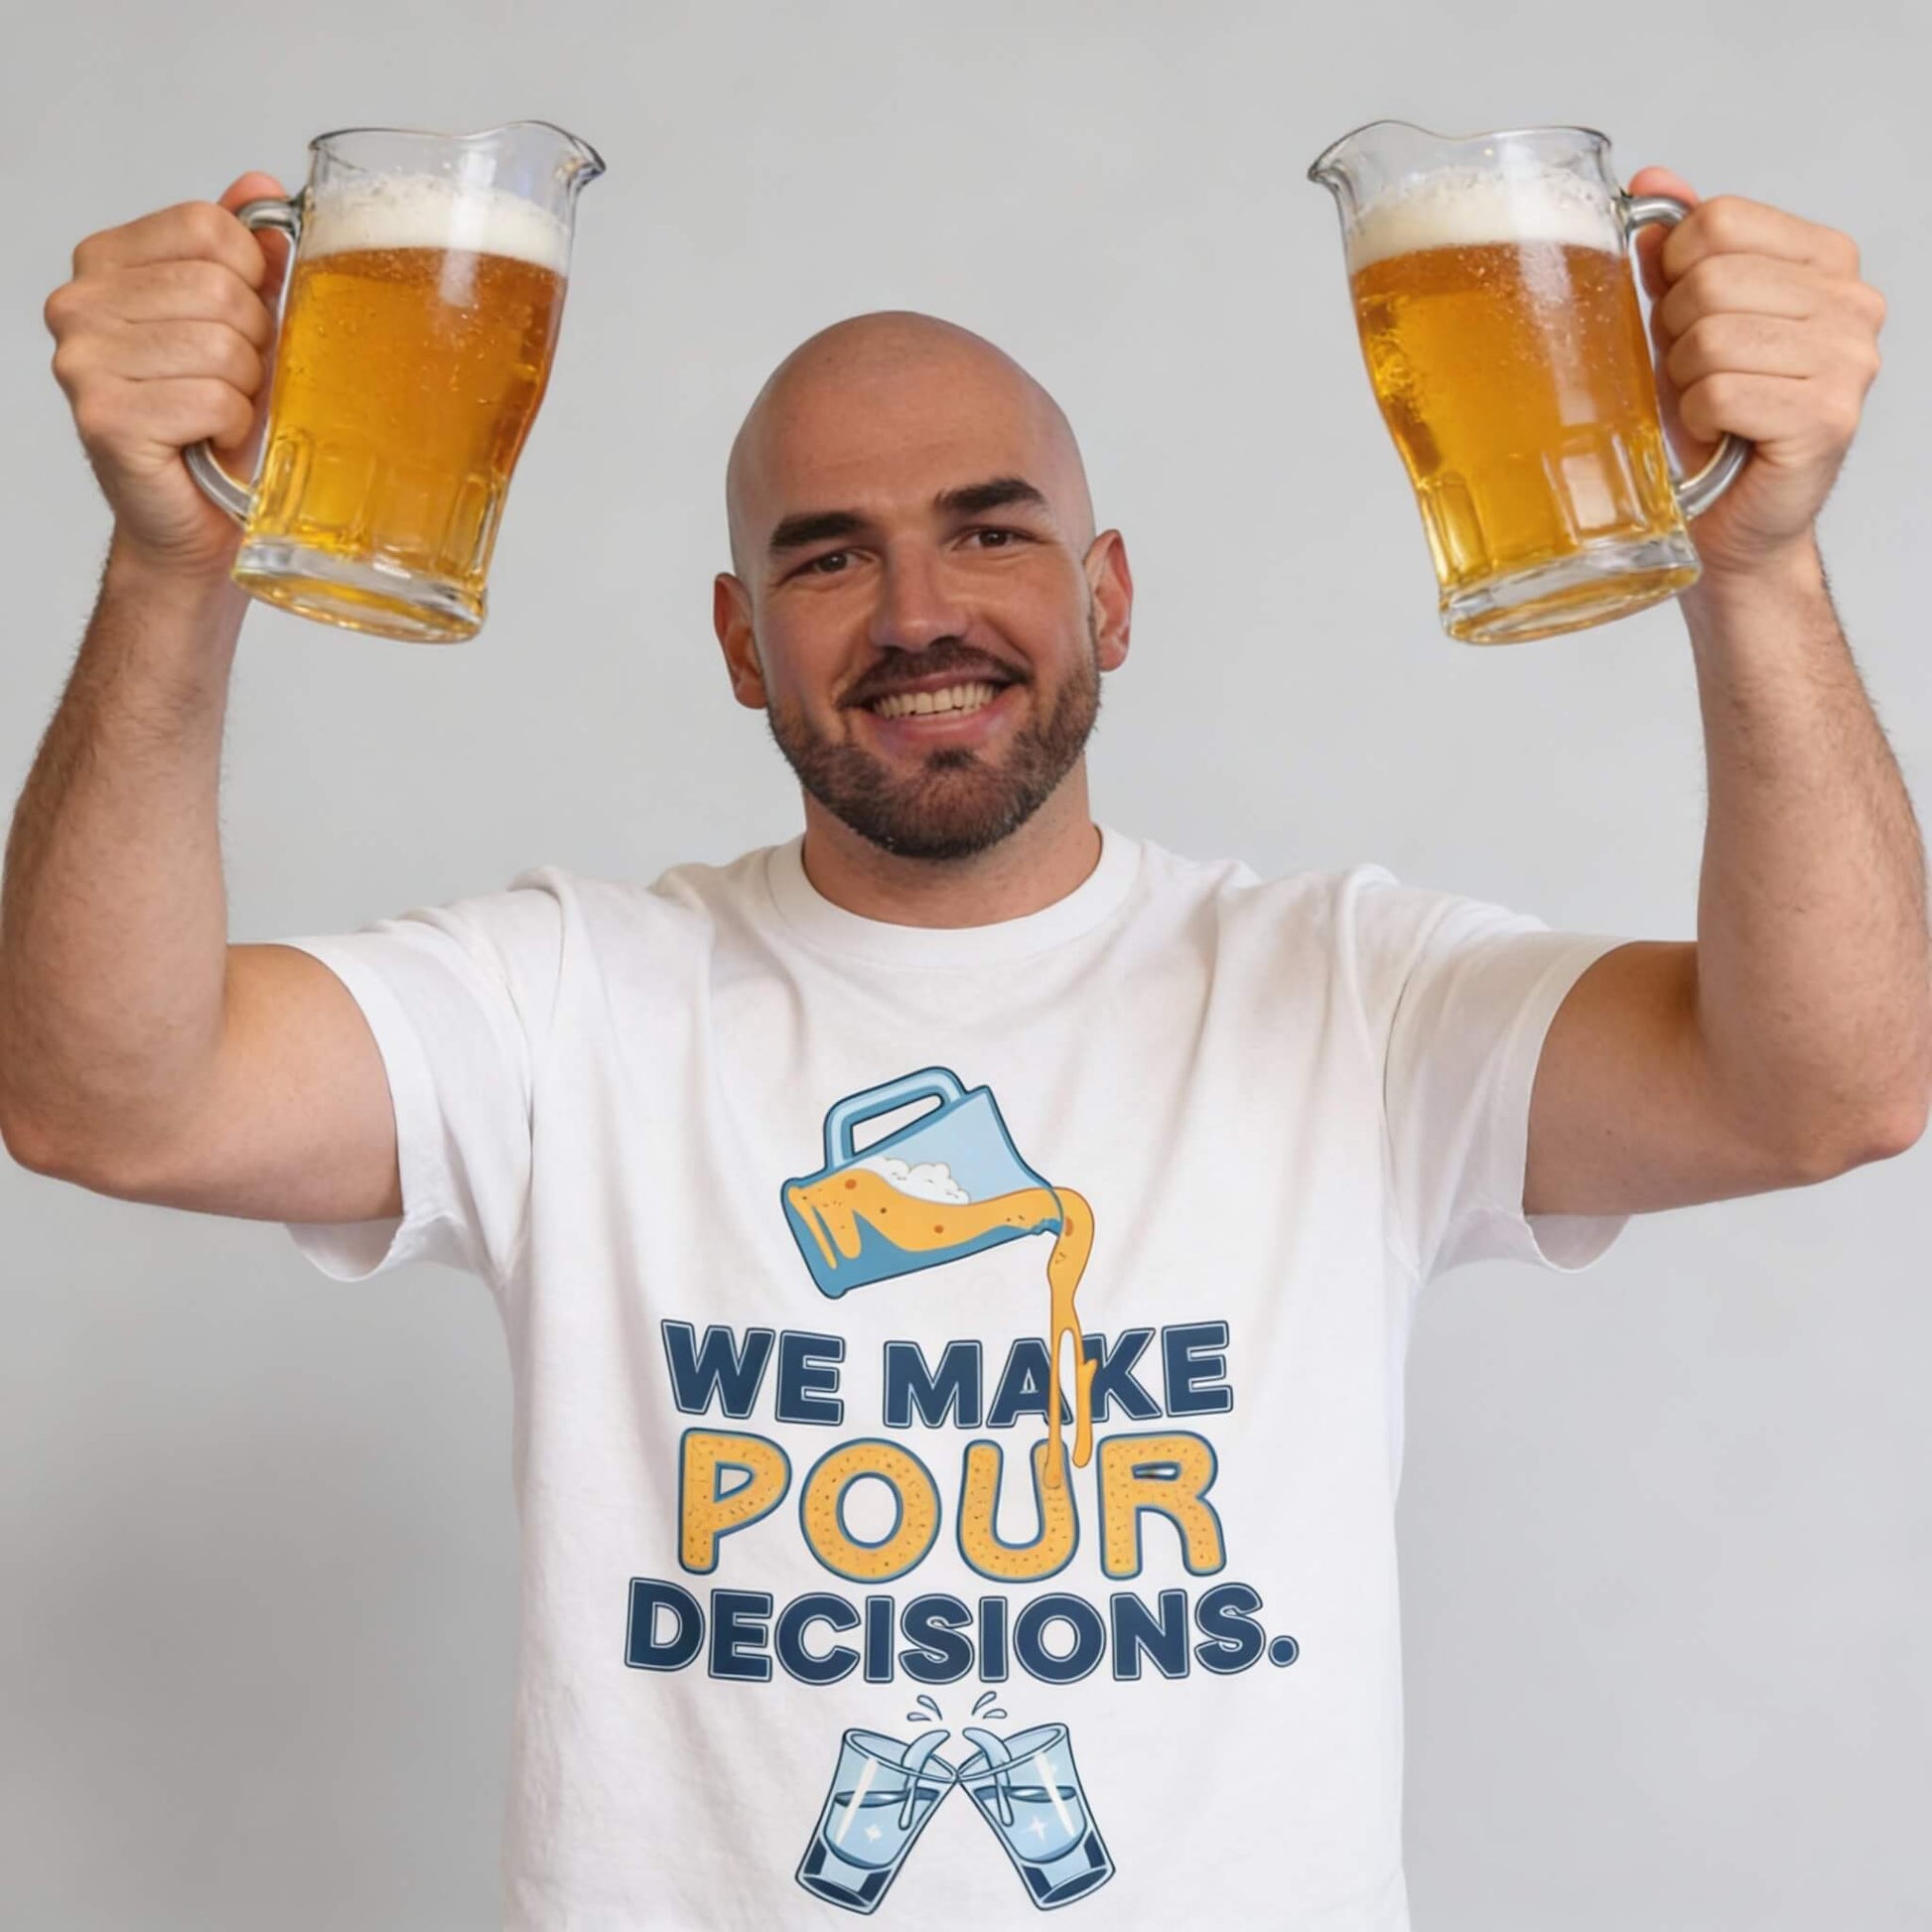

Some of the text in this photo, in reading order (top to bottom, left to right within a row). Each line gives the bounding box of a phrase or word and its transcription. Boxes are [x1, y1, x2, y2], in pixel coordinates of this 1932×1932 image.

[661, 1319, 1233, 1430] WE MAKE
[678, 1428, 1227, 1585] POUR
[624, 1577, 1300, 1686] DECISIONS.
